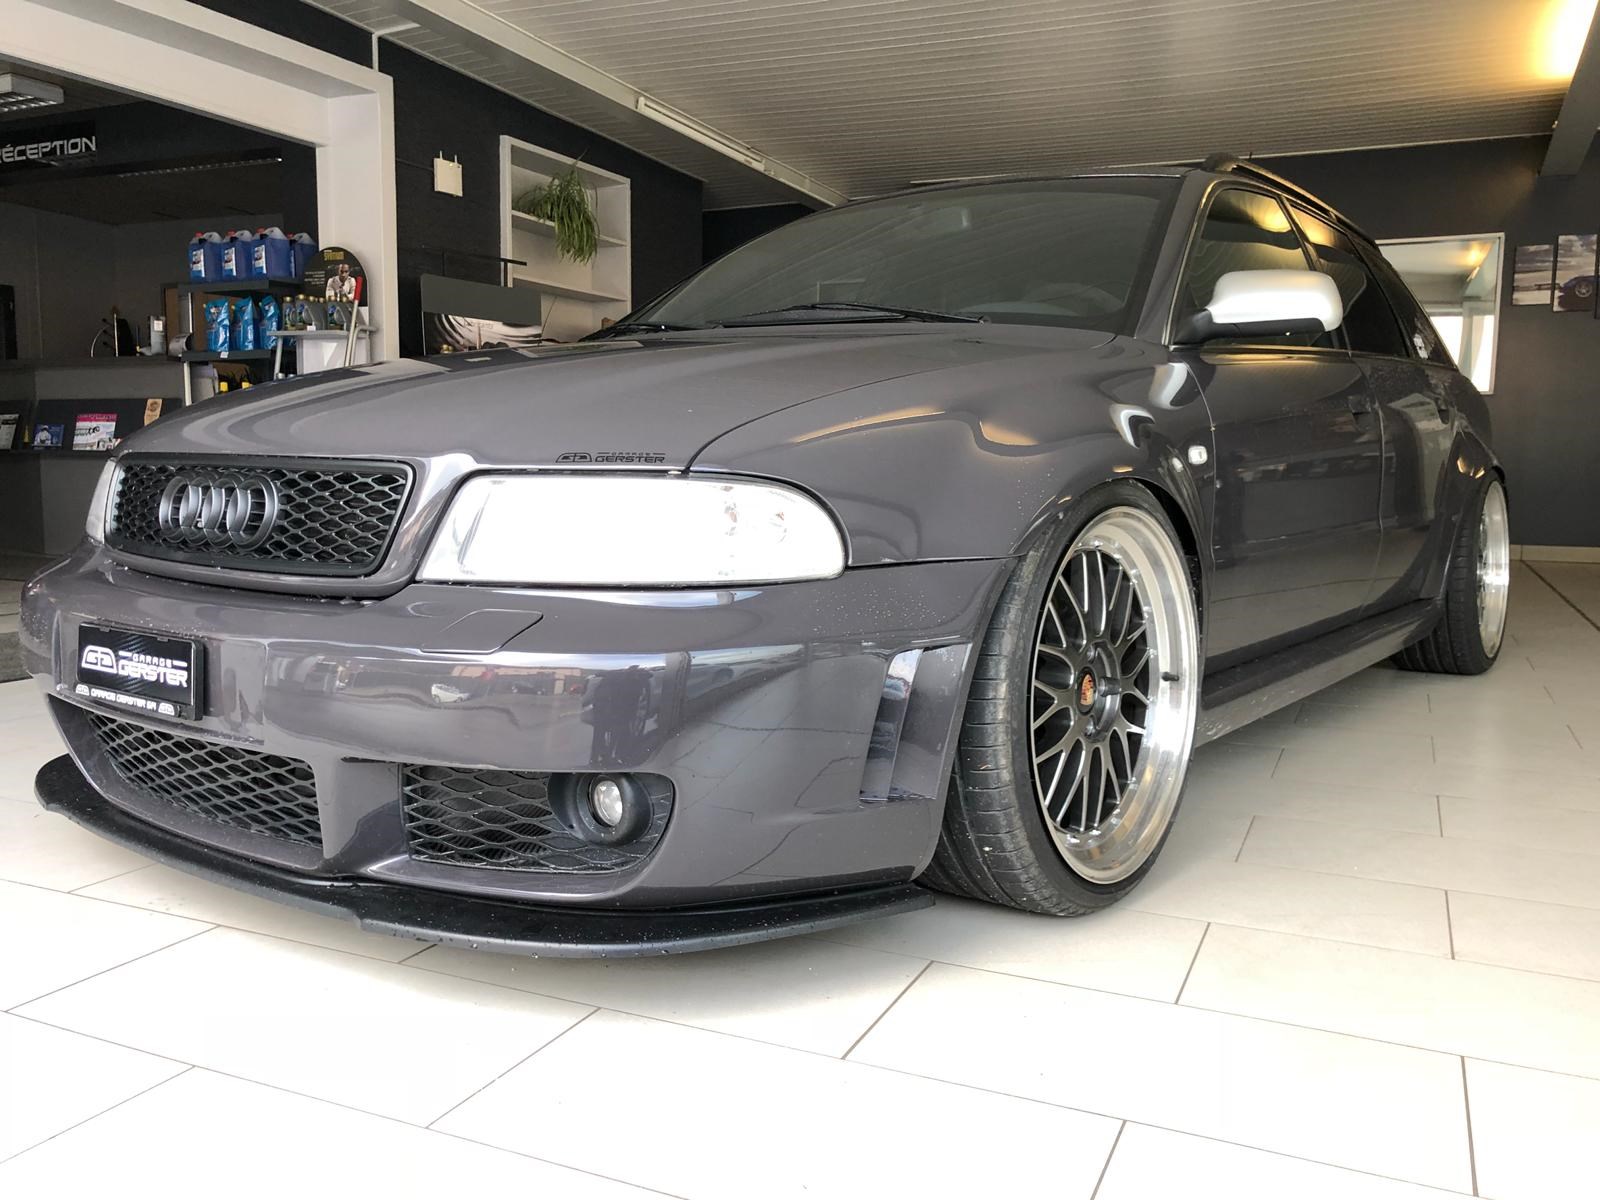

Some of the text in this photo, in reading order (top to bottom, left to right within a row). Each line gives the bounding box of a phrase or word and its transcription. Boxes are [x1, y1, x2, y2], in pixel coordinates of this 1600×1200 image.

[0, 136, 97, 164] ÉCEPTION
[595, 455, 665, 463] GERSTER
[118, 659, 188, 688] GERSTER
